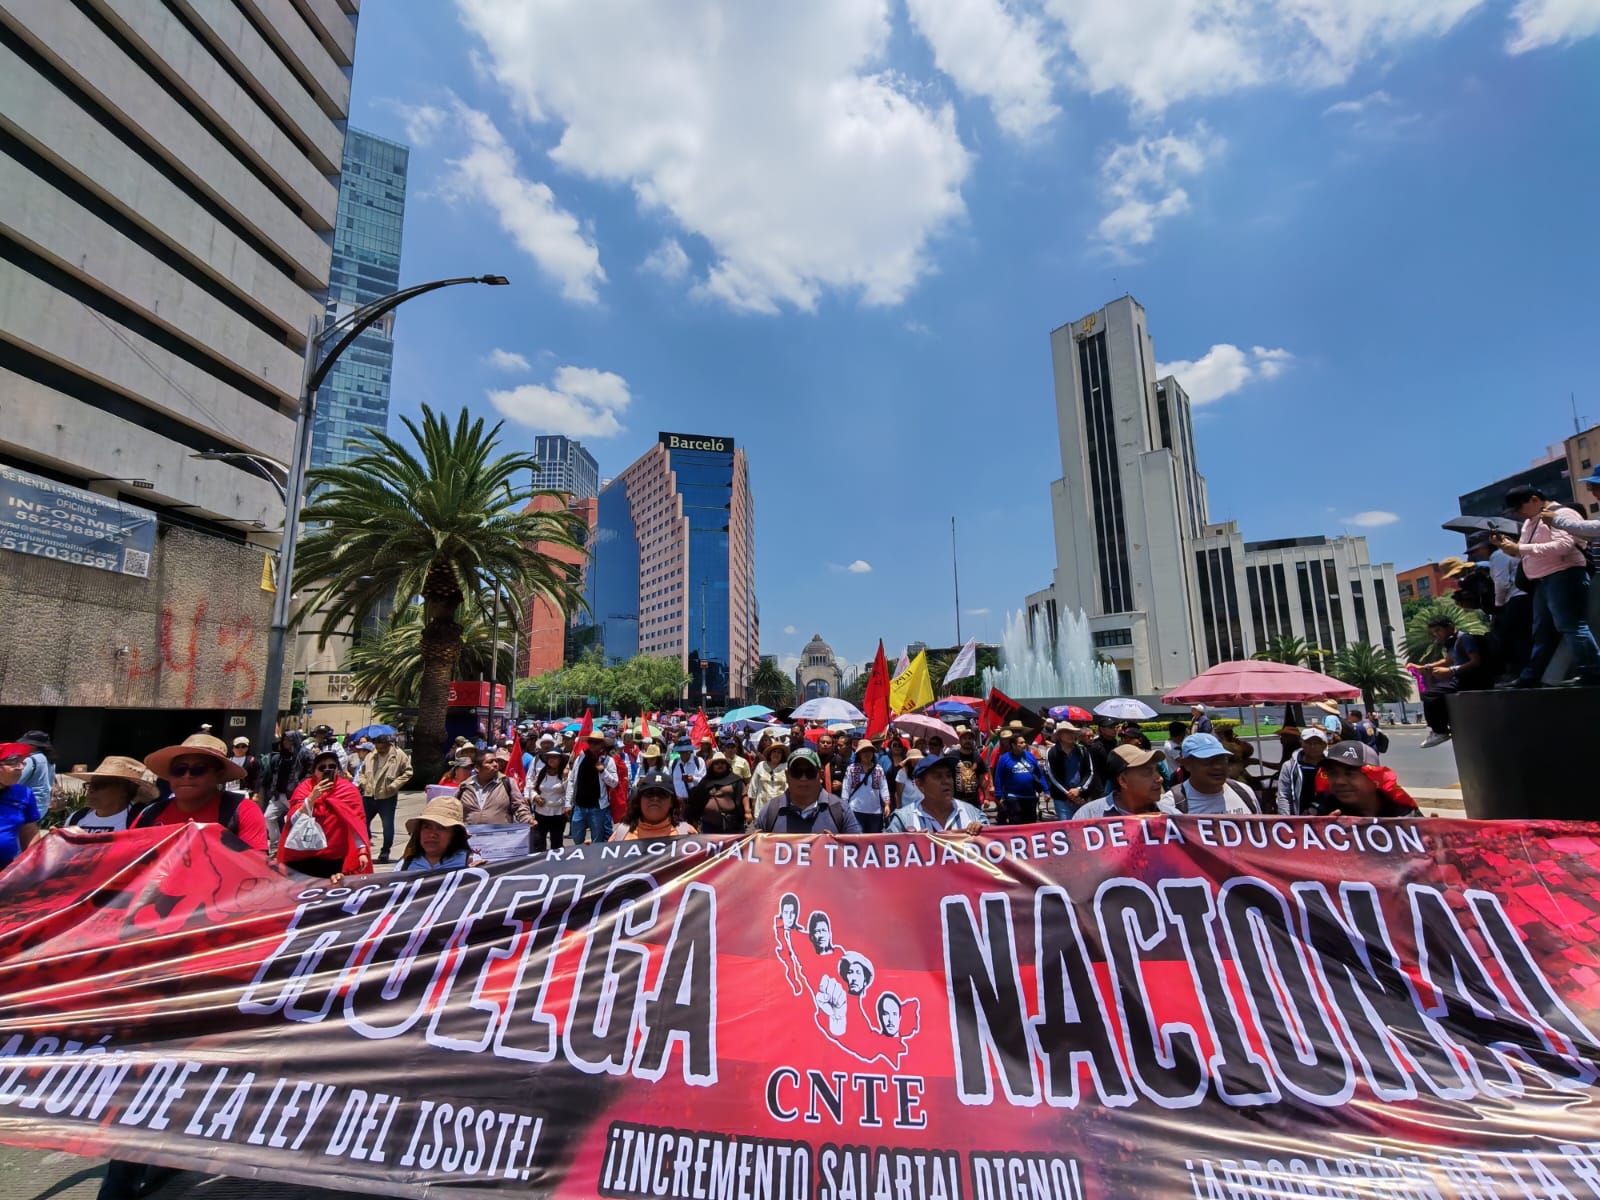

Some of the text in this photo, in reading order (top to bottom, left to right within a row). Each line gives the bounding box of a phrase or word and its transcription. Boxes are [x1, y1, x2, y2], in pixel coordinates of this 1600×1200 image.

[669, 435, 724, 452] Barceló
[17, 475, 51, 491] RENTA
[8, 496, 133, 537] INFORMES
[16, 510, 123, 545] 5522988932
[56, 498, 98, 517] OFICINAS
[601, 840, 760, 863] NACIONAL
[774, 842, 811, 866] DE
[824, 831, 1069, 869] TRABAJADORES
[1083, 821, 1129, 851] DE
[1141, 819, 1185, 846] LA
[1198, 817, 1426, 853] EDUCACIÓN
[940, 876, 1600, 1109] NACIONAL
[119, 1057, 202, 1131] DE
[184, 1066, 255, 1140] LA
[247, 1077, 336, 1151] LEY
[325, 1088, 401, 1162] DEL
[399, 1100, 543, 1181] ISSSTE!
[766, 1065, 928, 1130] CNTE
[602, 1127, 809, 1200] ¡INCREMENTO
